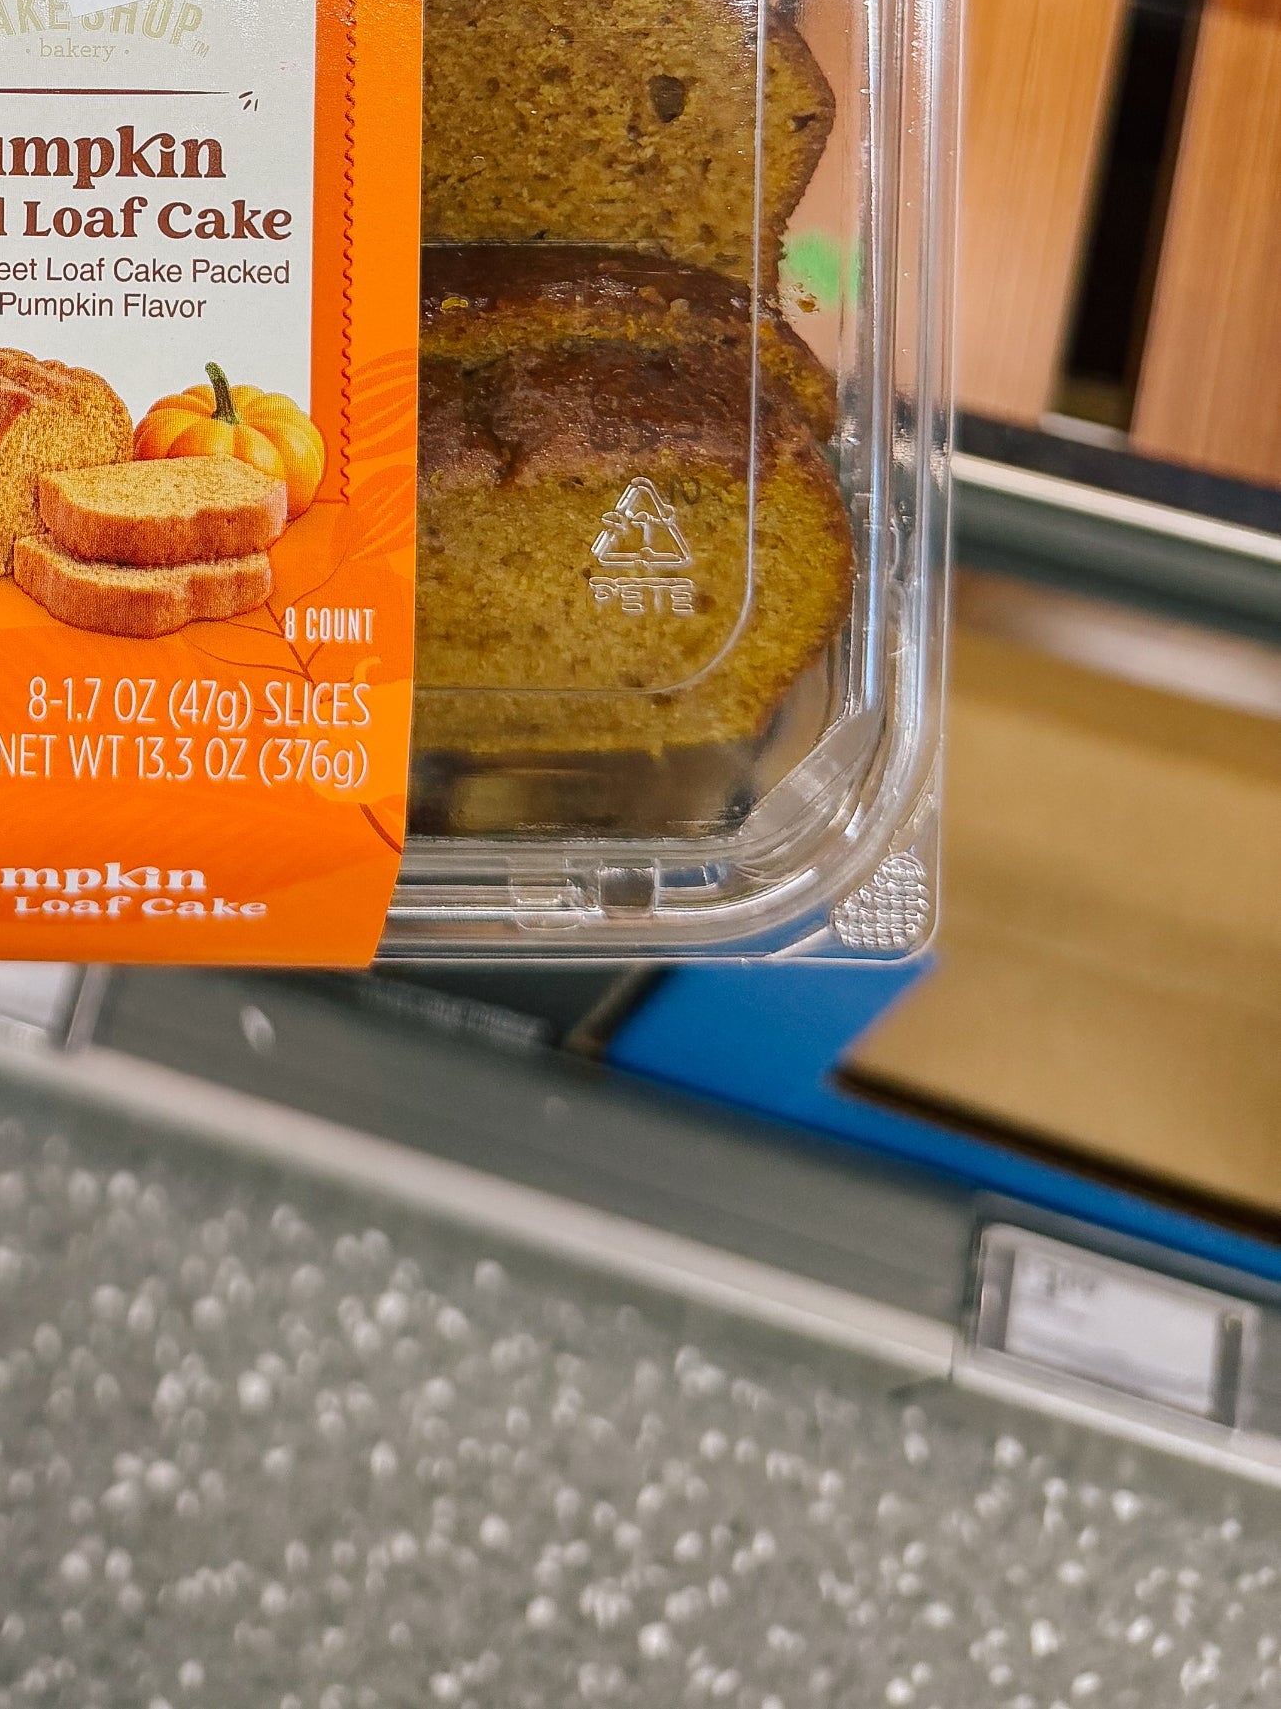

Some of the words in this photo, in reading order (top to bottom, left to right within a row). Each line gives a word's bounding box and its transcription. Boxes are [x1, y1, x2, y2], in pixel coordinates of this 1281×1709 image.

[40, 38, 116, 62] bakery
[22, 196, 148, 239] Loaf
[157, 199, 293, 241] Cake
[46, 256, 105, 282] Loaf
[113, 258, 183, 284] Cake
[192, 259, 290, 285] Packed
[0, 292, 114, 322] Pumpkin
[123, 293, 207, 319] Flavor
[589, 576, 695, 615] PETE
[284, 607, 297, 642] 8
[305, 607, 374, 644] COUNT
[27, 676, 102, 722] 8-1.7
[113, 677, 157, 723] OZ
[168, 678, 252, 731] (47g)
[263, 680, 371, 728] SLICES
[68, 733, 124, 779] WT
[135, 735, 193, 781] 13.3
[204, 737, 249, 782] OZ
[258, 738, 368, 789] (376g)
[14, 895, 132, 916] Loaf
[141, 897, 267, 917] Cake
